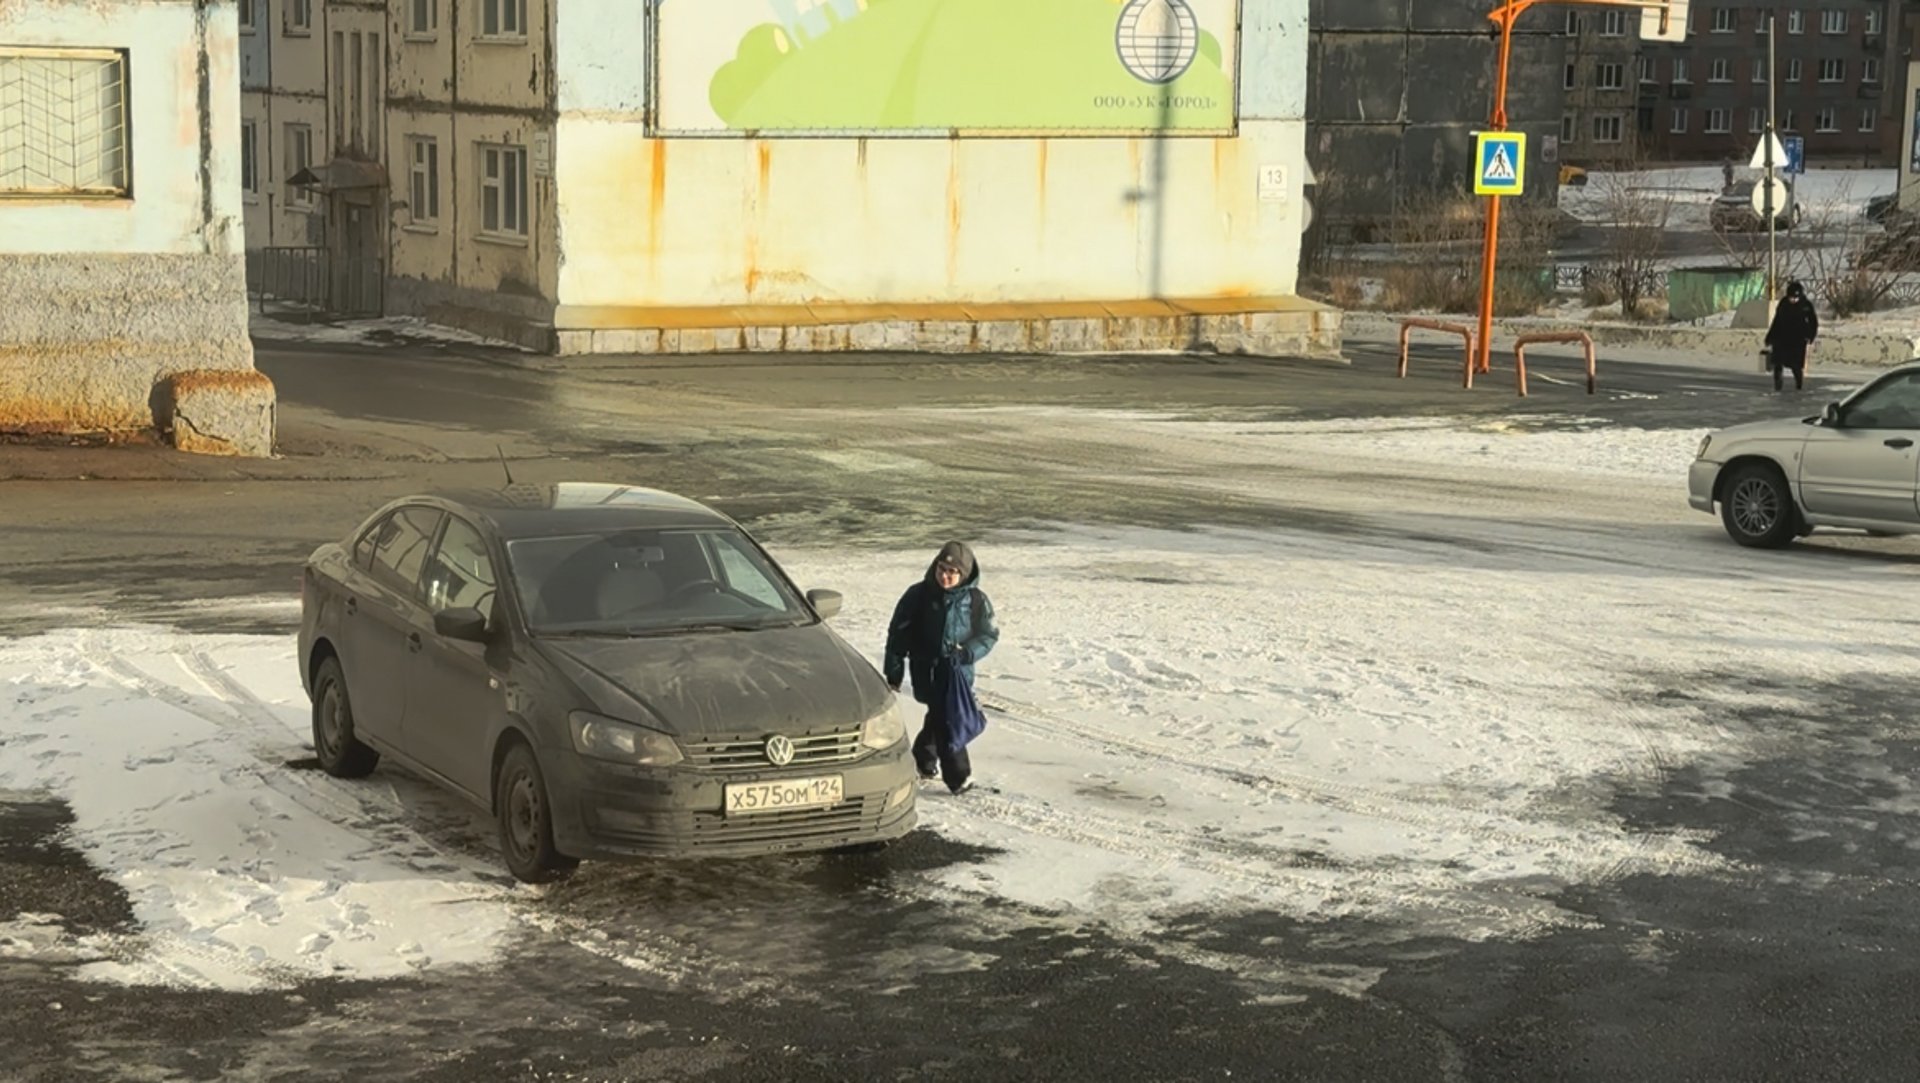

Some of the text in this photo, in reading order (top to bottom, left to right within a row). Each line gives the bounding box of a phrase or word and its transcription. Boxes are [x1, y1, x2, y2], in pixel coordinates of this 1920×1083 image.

[1093, 96, 1126, 108] ООО
[1267, 169, 1282, 184] 13
[812, 779, 840, 796] 124
